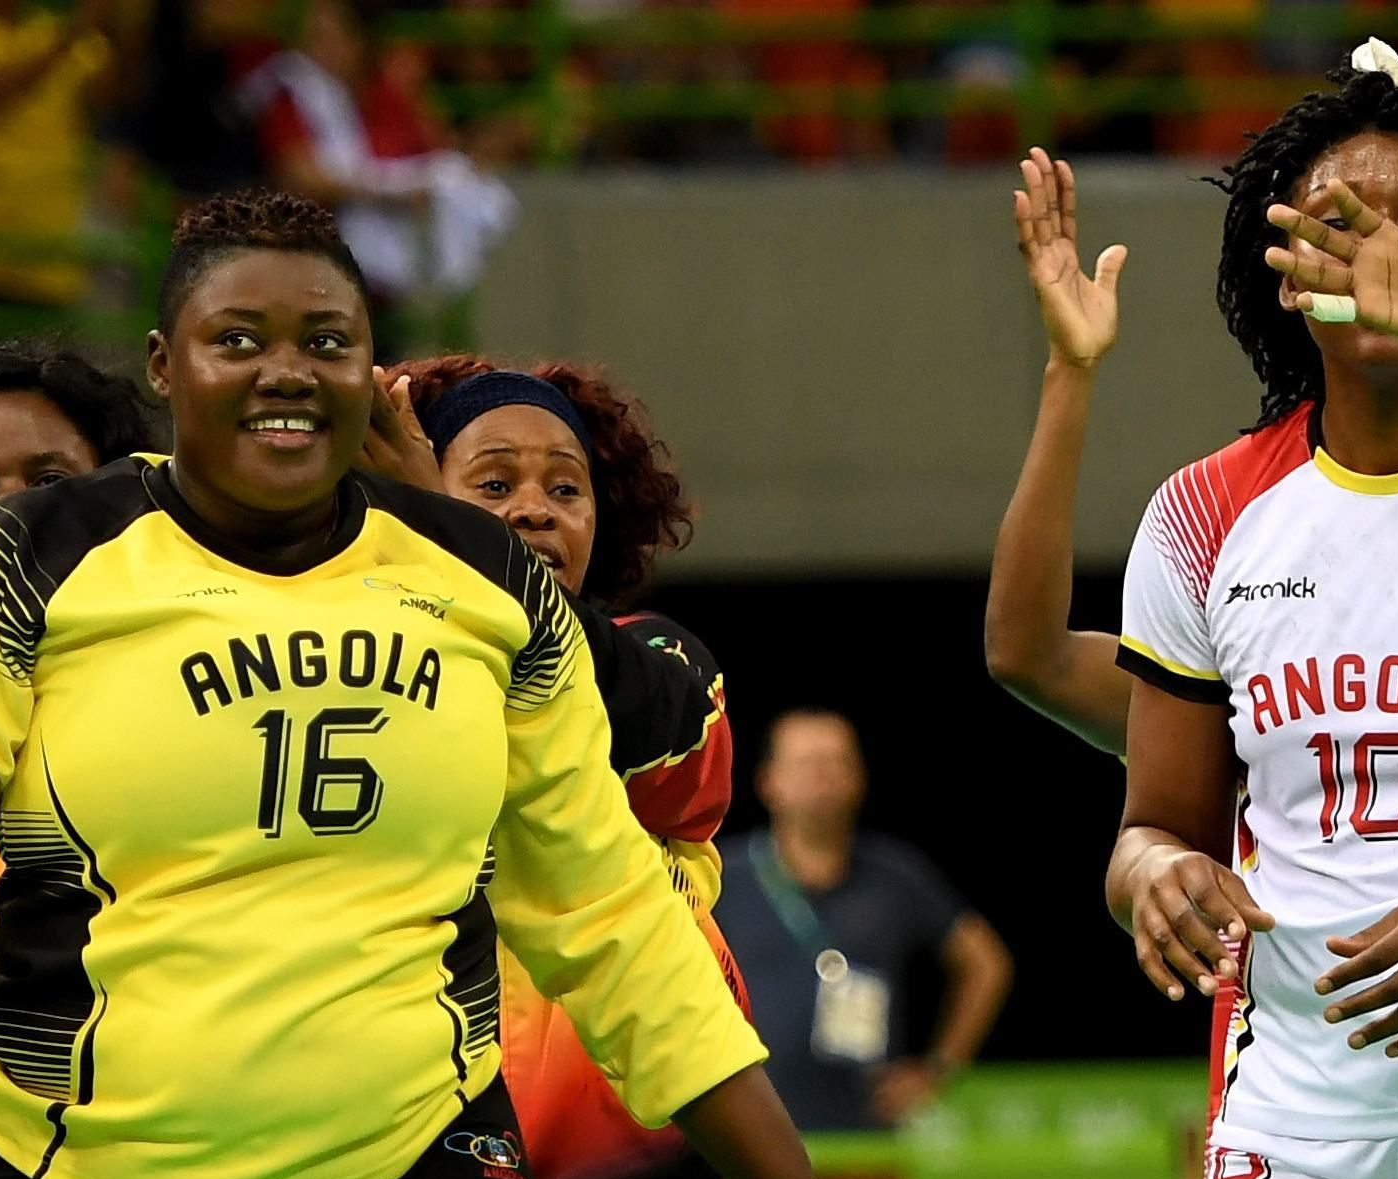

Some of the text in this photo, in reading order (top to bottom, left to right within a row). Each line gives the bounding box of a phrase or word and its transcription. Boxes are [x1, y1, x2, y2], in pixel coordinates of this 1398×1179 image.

[400, 598, 446, 622] ANGOLA
[180, 629, 442, 716] ANGOLA
[252, 707, 391, 839] 16
